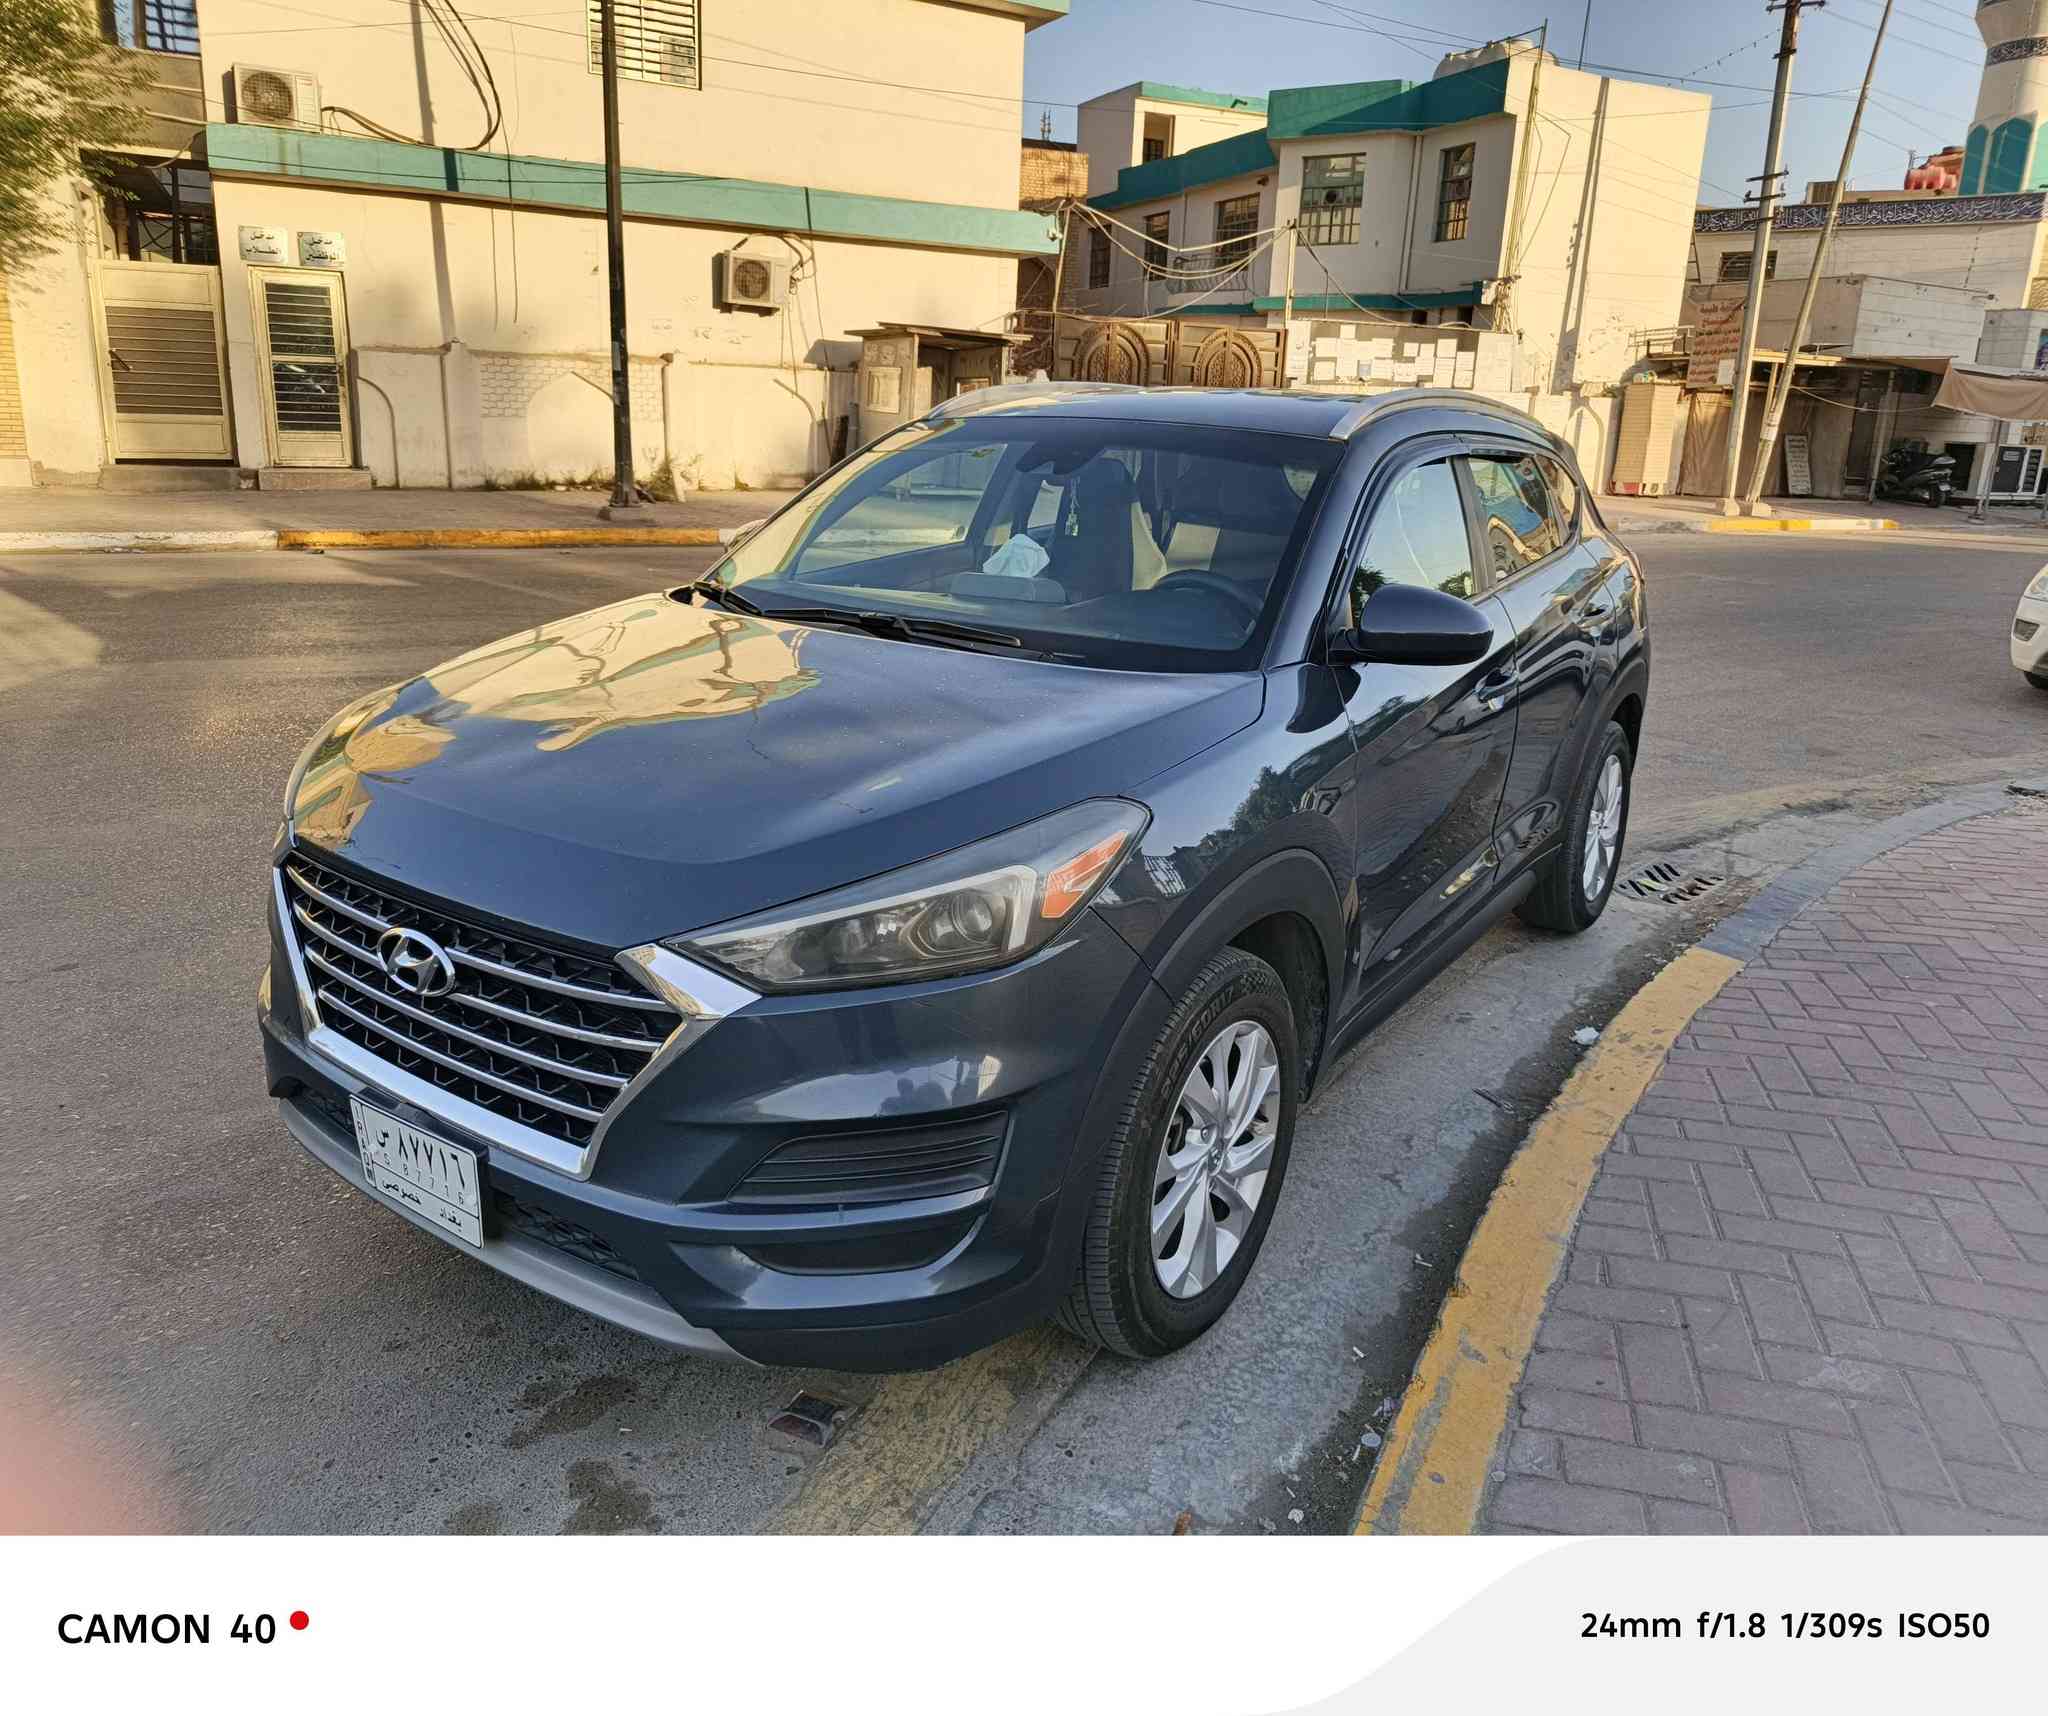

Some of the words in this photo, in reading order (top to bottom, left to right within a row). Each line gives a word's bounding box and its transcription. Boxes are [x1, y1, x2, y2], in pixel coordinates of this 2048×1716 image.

[398, 1127, 465, 1189] ٨٧٧١٦
[382, 1178, 422, 1206] خصوصي
[439, 1206, 462, 1233] بغداد
